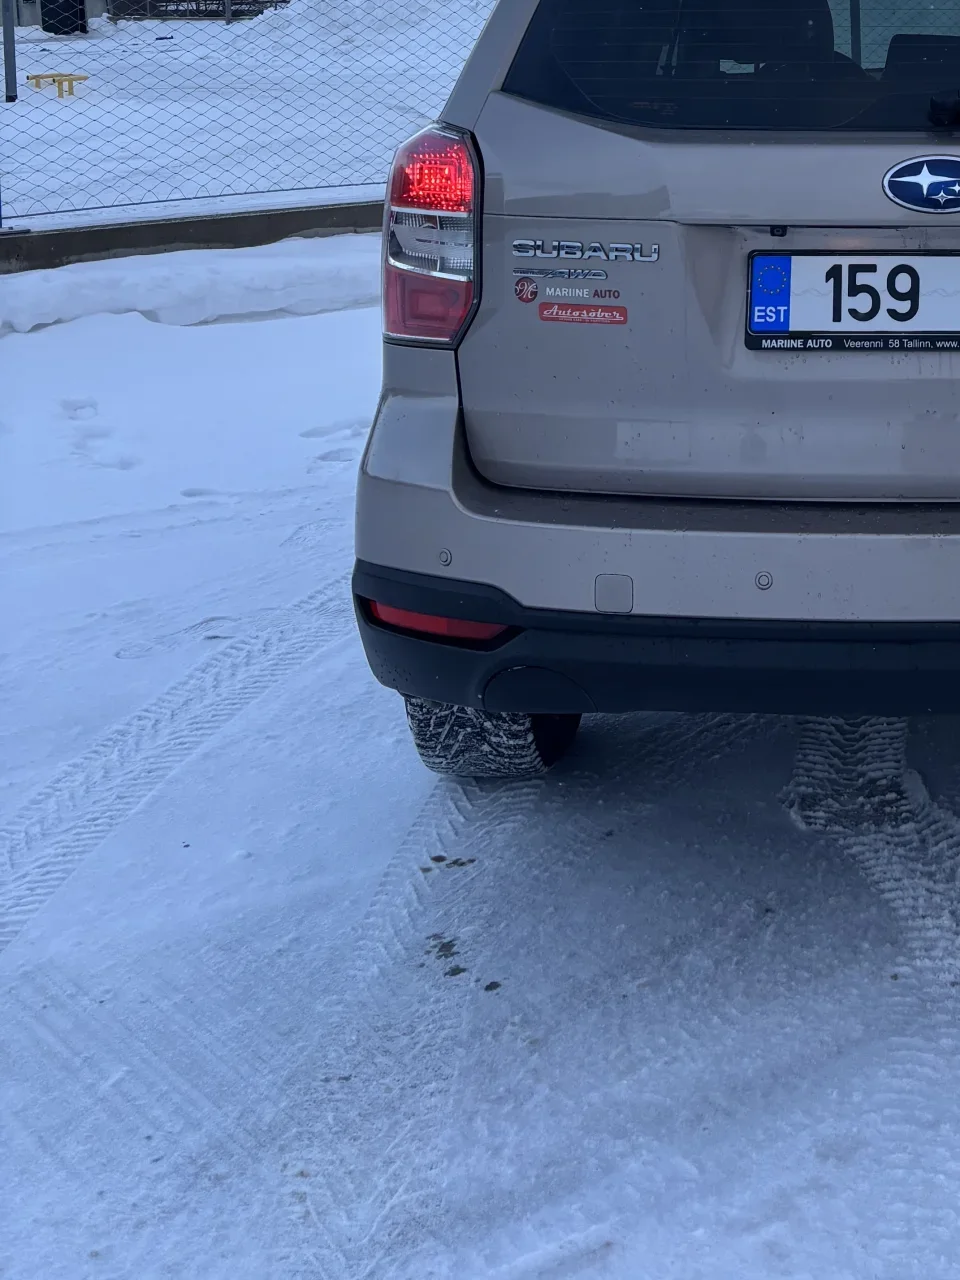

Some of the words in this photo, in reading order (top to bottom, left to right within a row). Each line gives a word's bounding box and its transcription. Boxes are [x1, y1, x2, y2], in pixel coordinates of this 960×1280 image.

[512, 239, 660, 263] SUBARU
[547, 269, 607, 280] AWD
[546, 287, 589, 298] MARIINE
[592, 289, 621, 299] AUTO
[825, 263, 920, 323] 159
[543, 304, 623, 320] Autosõber
[754, 306, 788, 323] EST
[762, 339, 804, 348] MARIINE
[806, 339, 832, 348] AUTO
[843, 339, 883, 348] Veerenni
[888, 339, 900, 348] 58
[902, 339, 934, 349] Tallinn,
